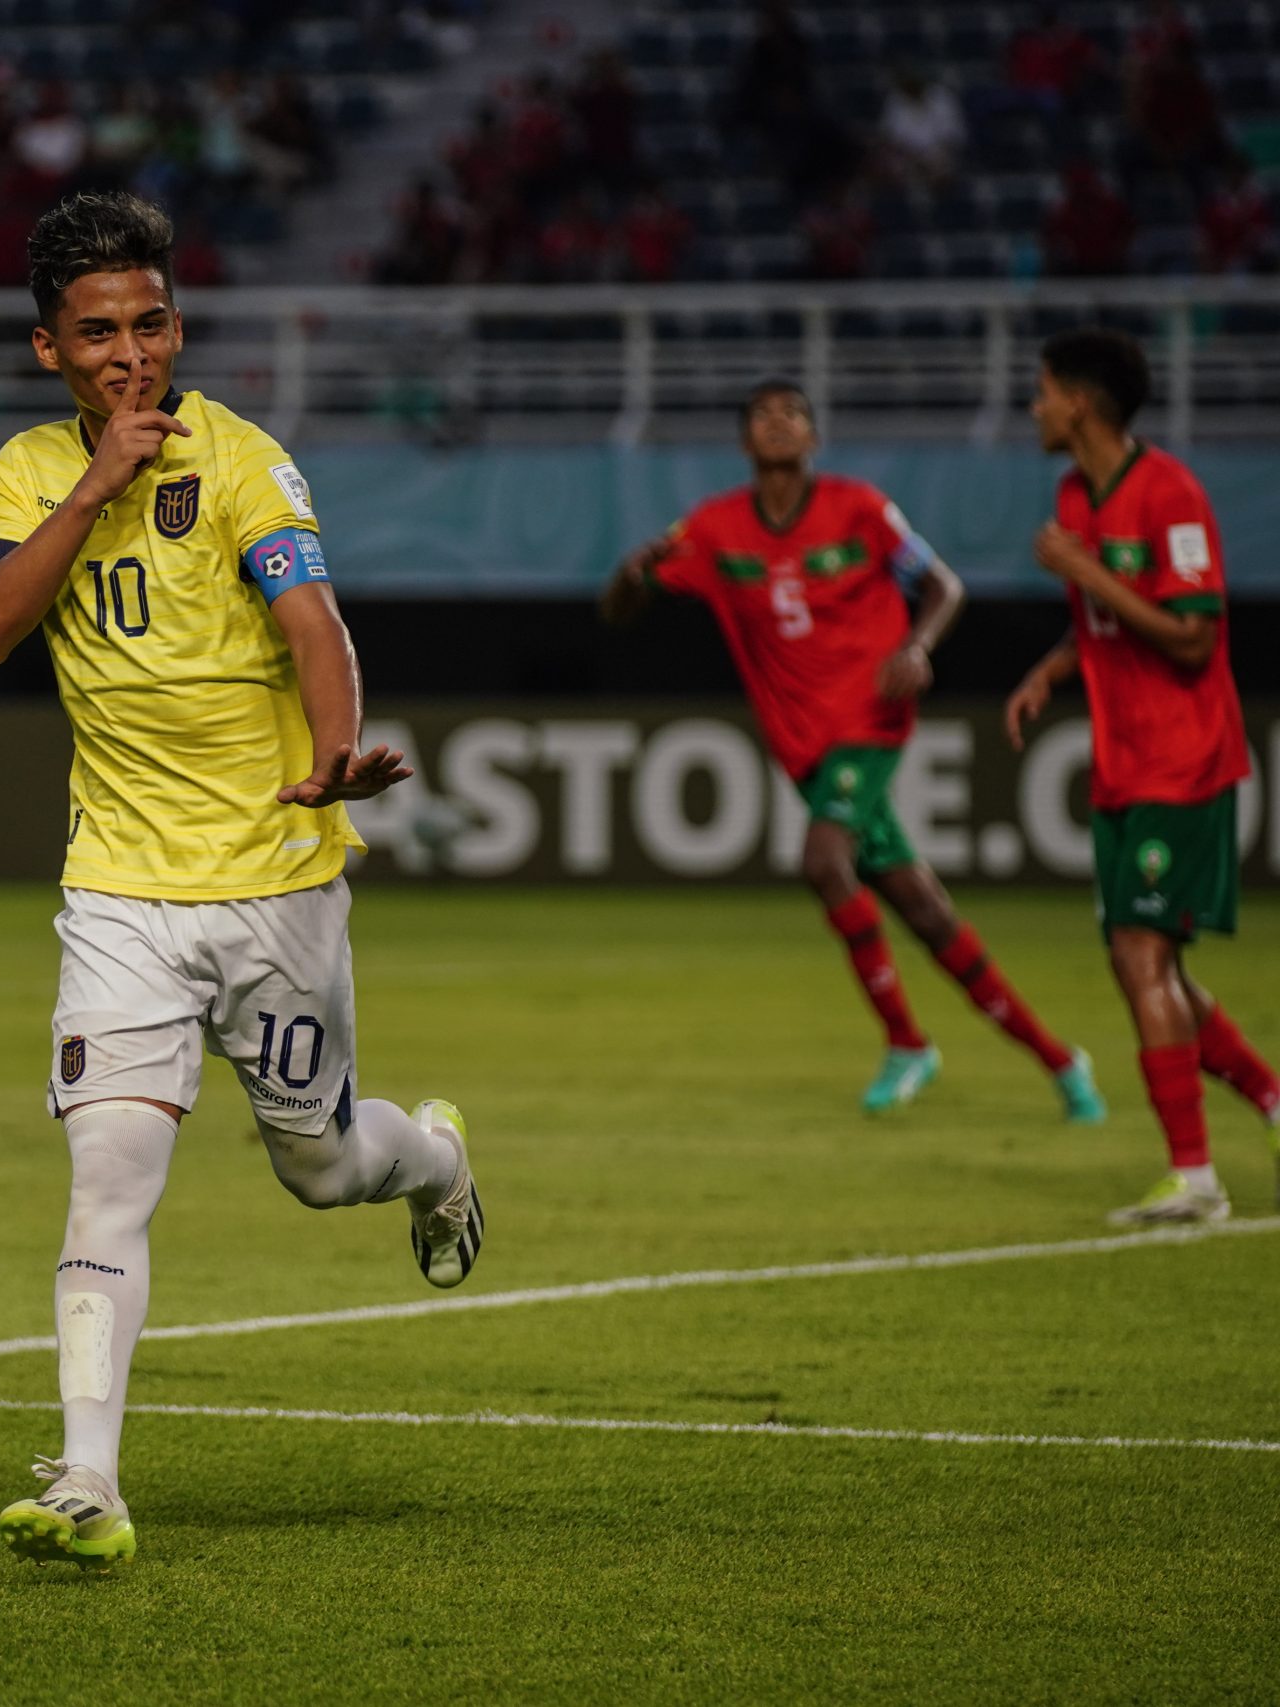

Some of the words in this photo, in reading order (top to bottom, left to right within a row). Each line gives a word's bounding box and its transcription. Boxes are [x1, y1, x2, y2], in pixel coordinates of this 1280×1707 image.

[86, 557, 150, 637] 10
[772, 578, 812, 639] 5
[258, 1010, 324, 1089] 10
[248, 1075, 322, 1110] marathon
